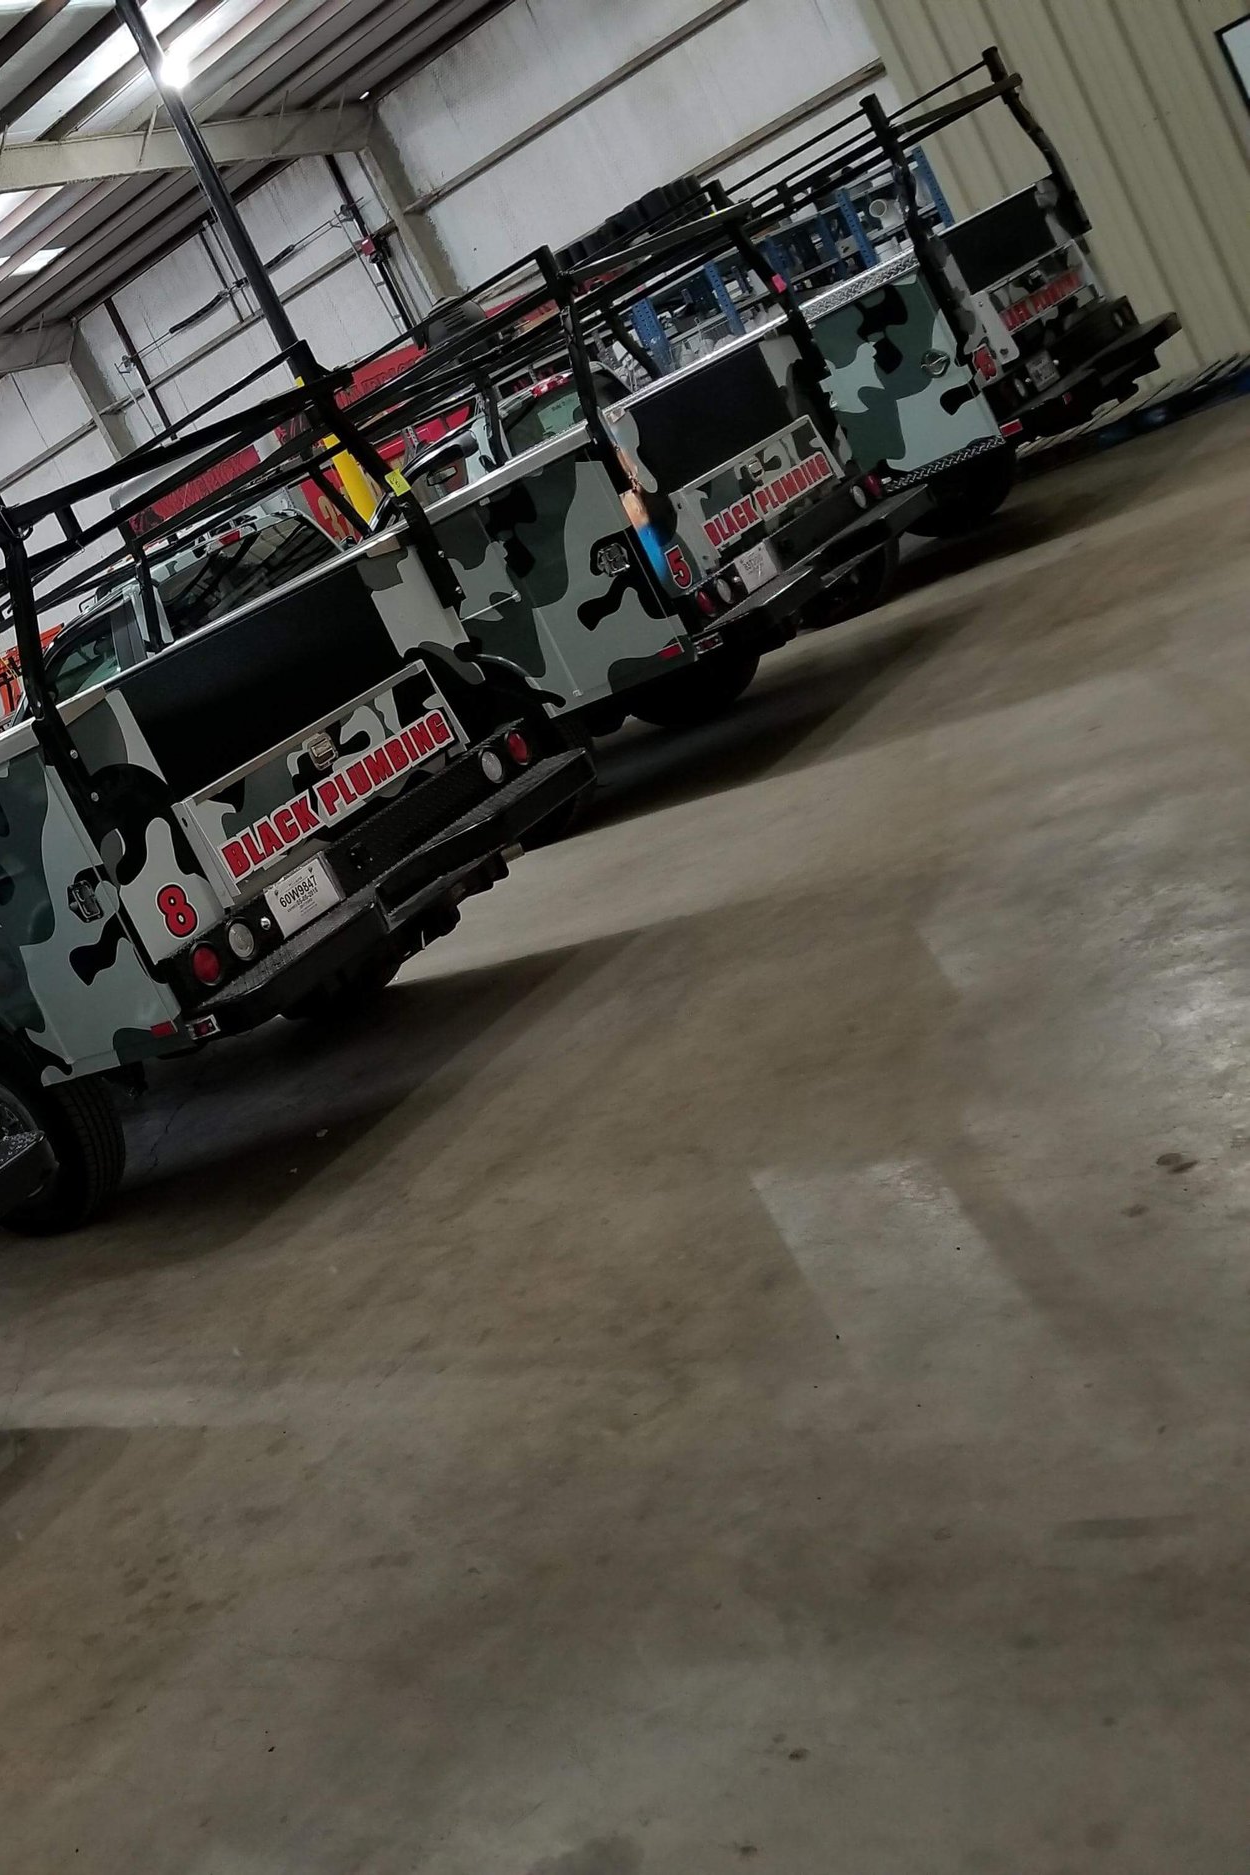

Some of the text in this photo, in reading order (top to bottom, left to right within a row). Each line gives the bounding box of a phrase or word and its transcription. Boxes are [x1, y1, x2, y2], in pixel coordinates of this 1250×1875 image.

[703, 453, 831, 547] BLACK PLUMBING
[665, 546, 692, 588] 5
[221, 712, 451, 878] BLACK PLUMBING
[156, 883, 198, 938] 8
[279, 875, 318, 907] 60W9847
